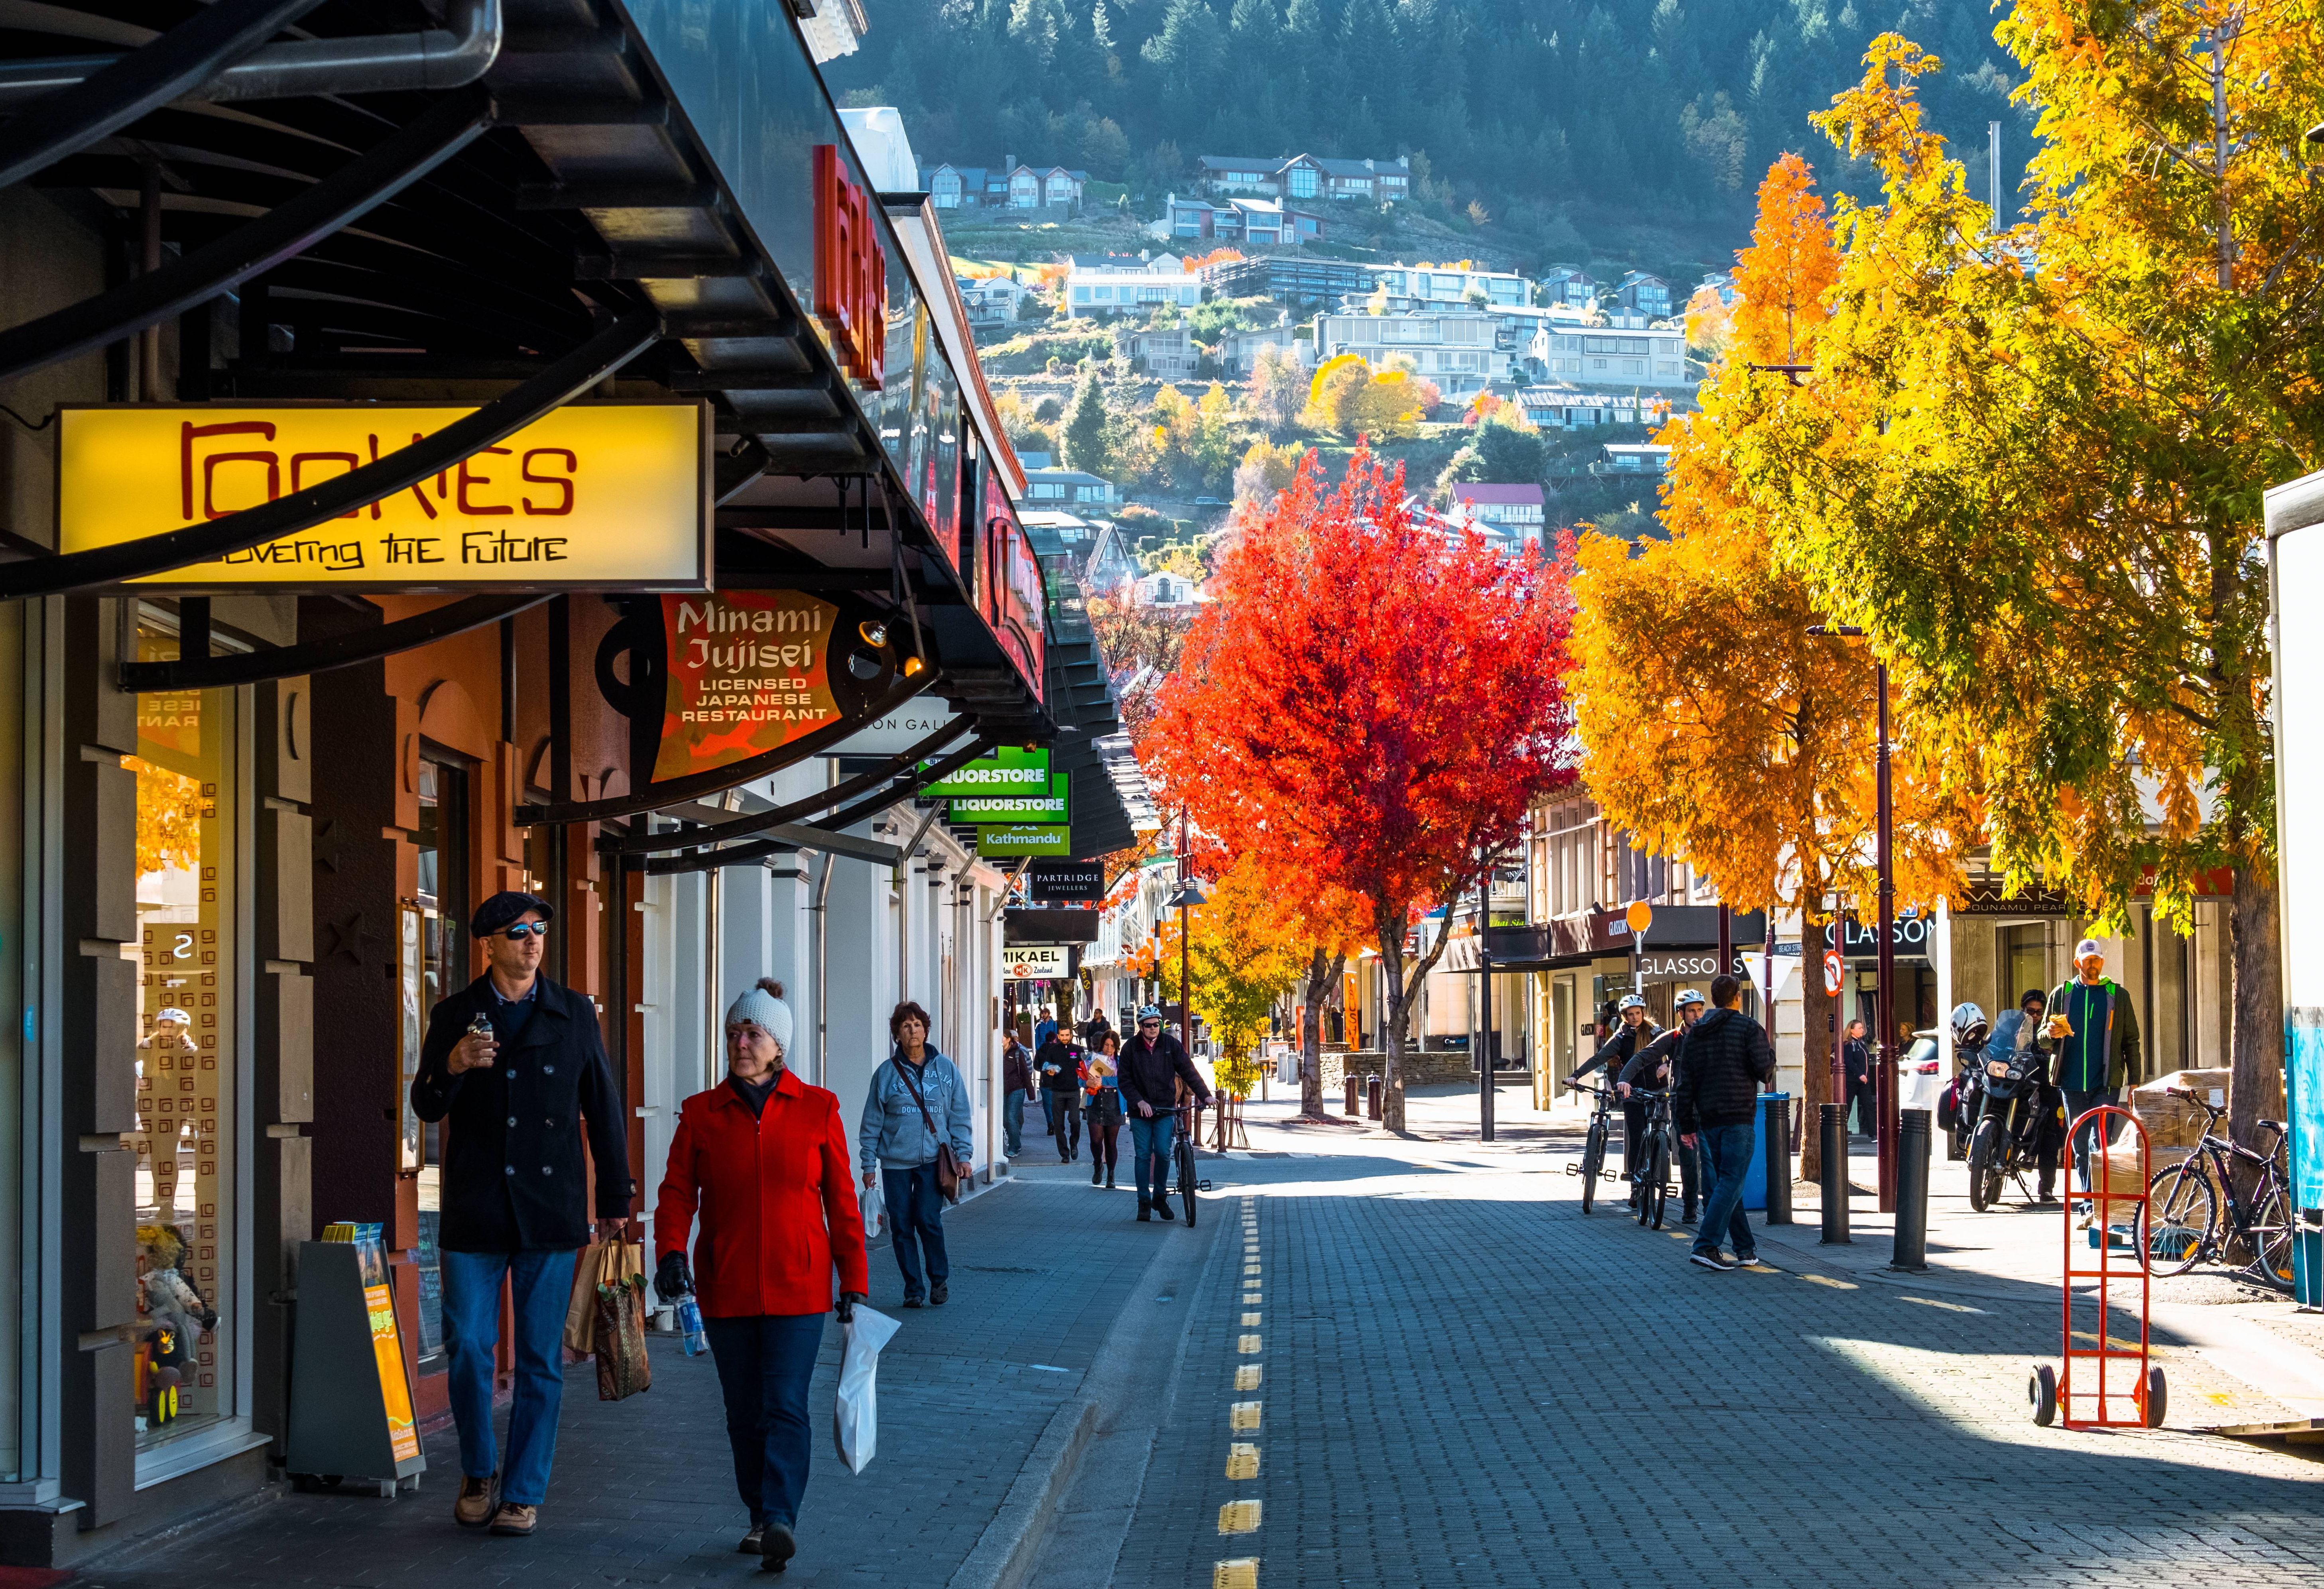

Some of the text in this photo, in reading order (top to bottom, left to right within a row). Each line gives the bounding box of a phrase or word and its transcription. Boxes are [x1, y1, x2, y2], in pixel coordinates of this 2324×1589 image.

[678, 600, 821, 633] Minami
[700, 678, 807, 690] LICENSED
[696, 694, 811, 706] JAPANESE
[682, 709, 827, 722] RESTAURANT
[953, 798, 1064, 811] LIQUORSTORE
[986, 833, 1061, 844] Kathmandu
[1609, 919, 1627, 936] GLASSONS
[1779, 944, 1791, 952] BEACH
[1641, 958, 1743, 974] GLASSOS
